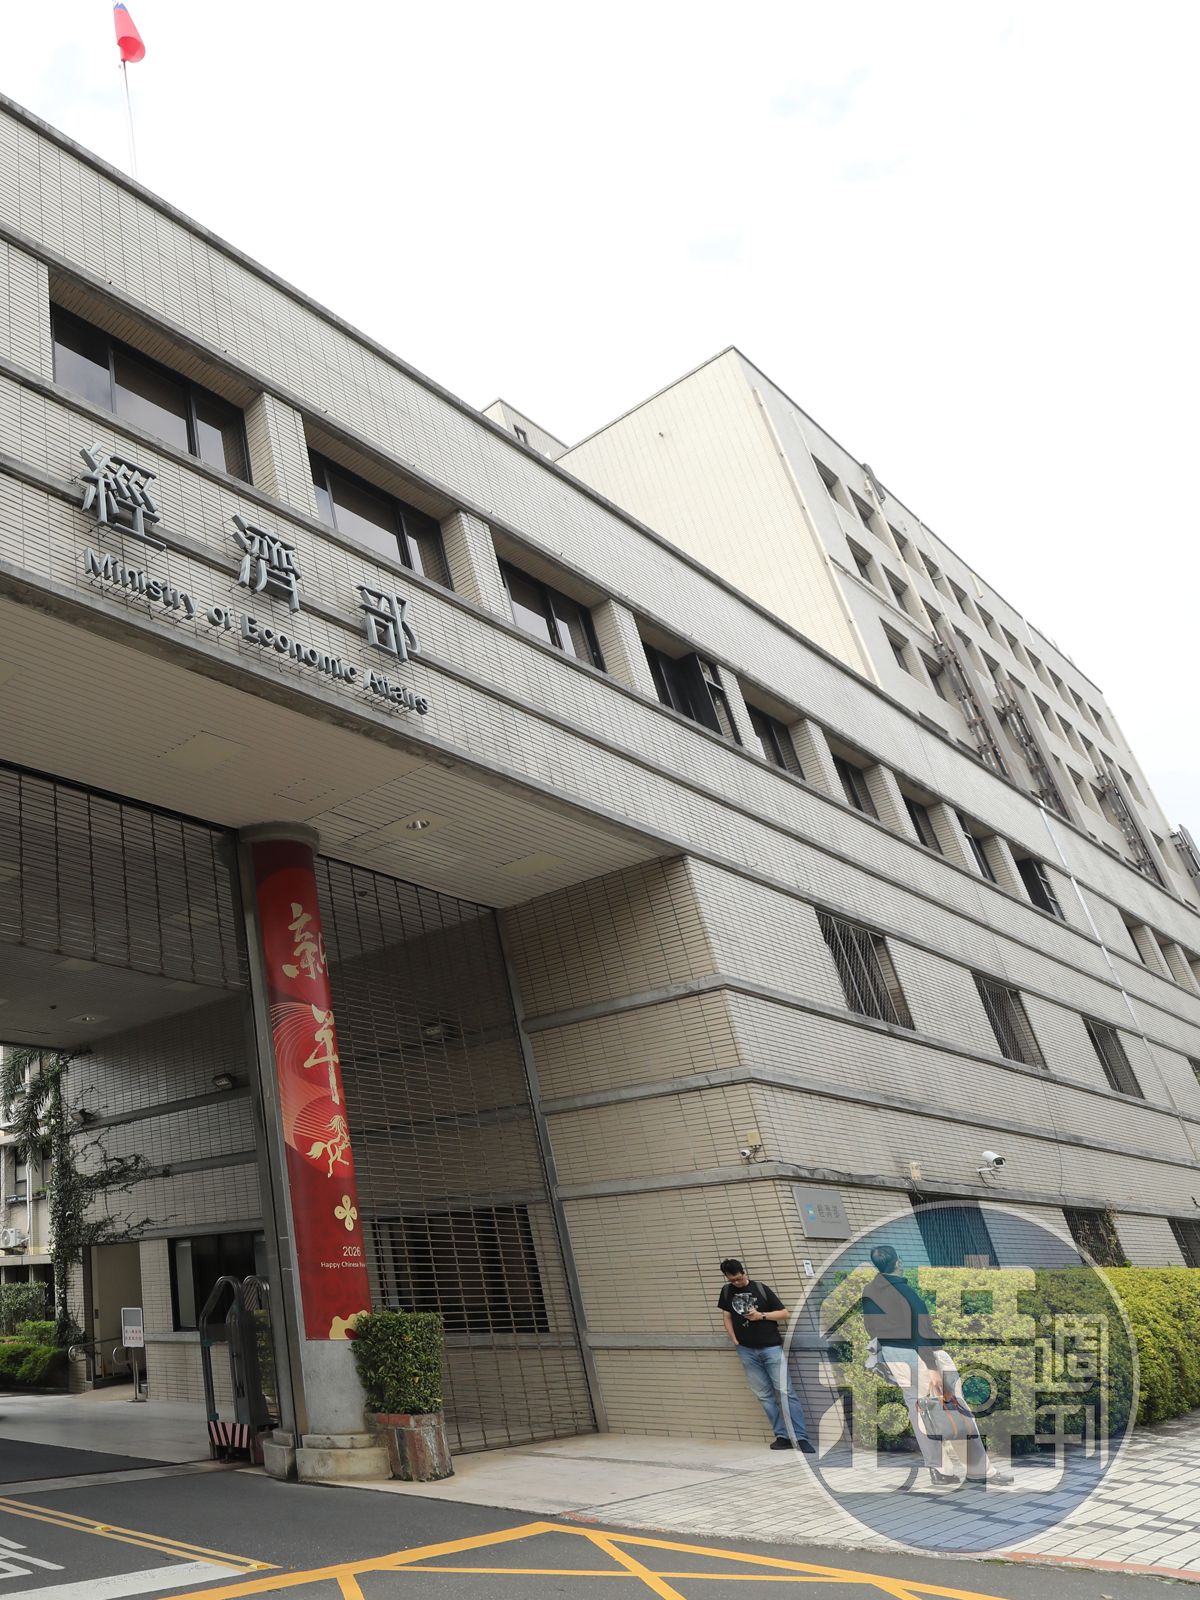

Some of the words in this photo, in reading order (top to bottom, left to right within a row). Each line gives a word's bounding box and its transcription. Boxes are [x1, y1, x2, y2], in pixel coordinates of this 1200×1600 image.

[79, 441, 421, 663] 經濟部
[83, 547, 197, 620] Ministry
[207, 606, 233, 630] of
[240, 614, 358, 685] Economic
[362, 668, 429, 716] Affairs
[320, 1261, 340, 1269] Happy
[342, 1246, 362, 1257] 2026
